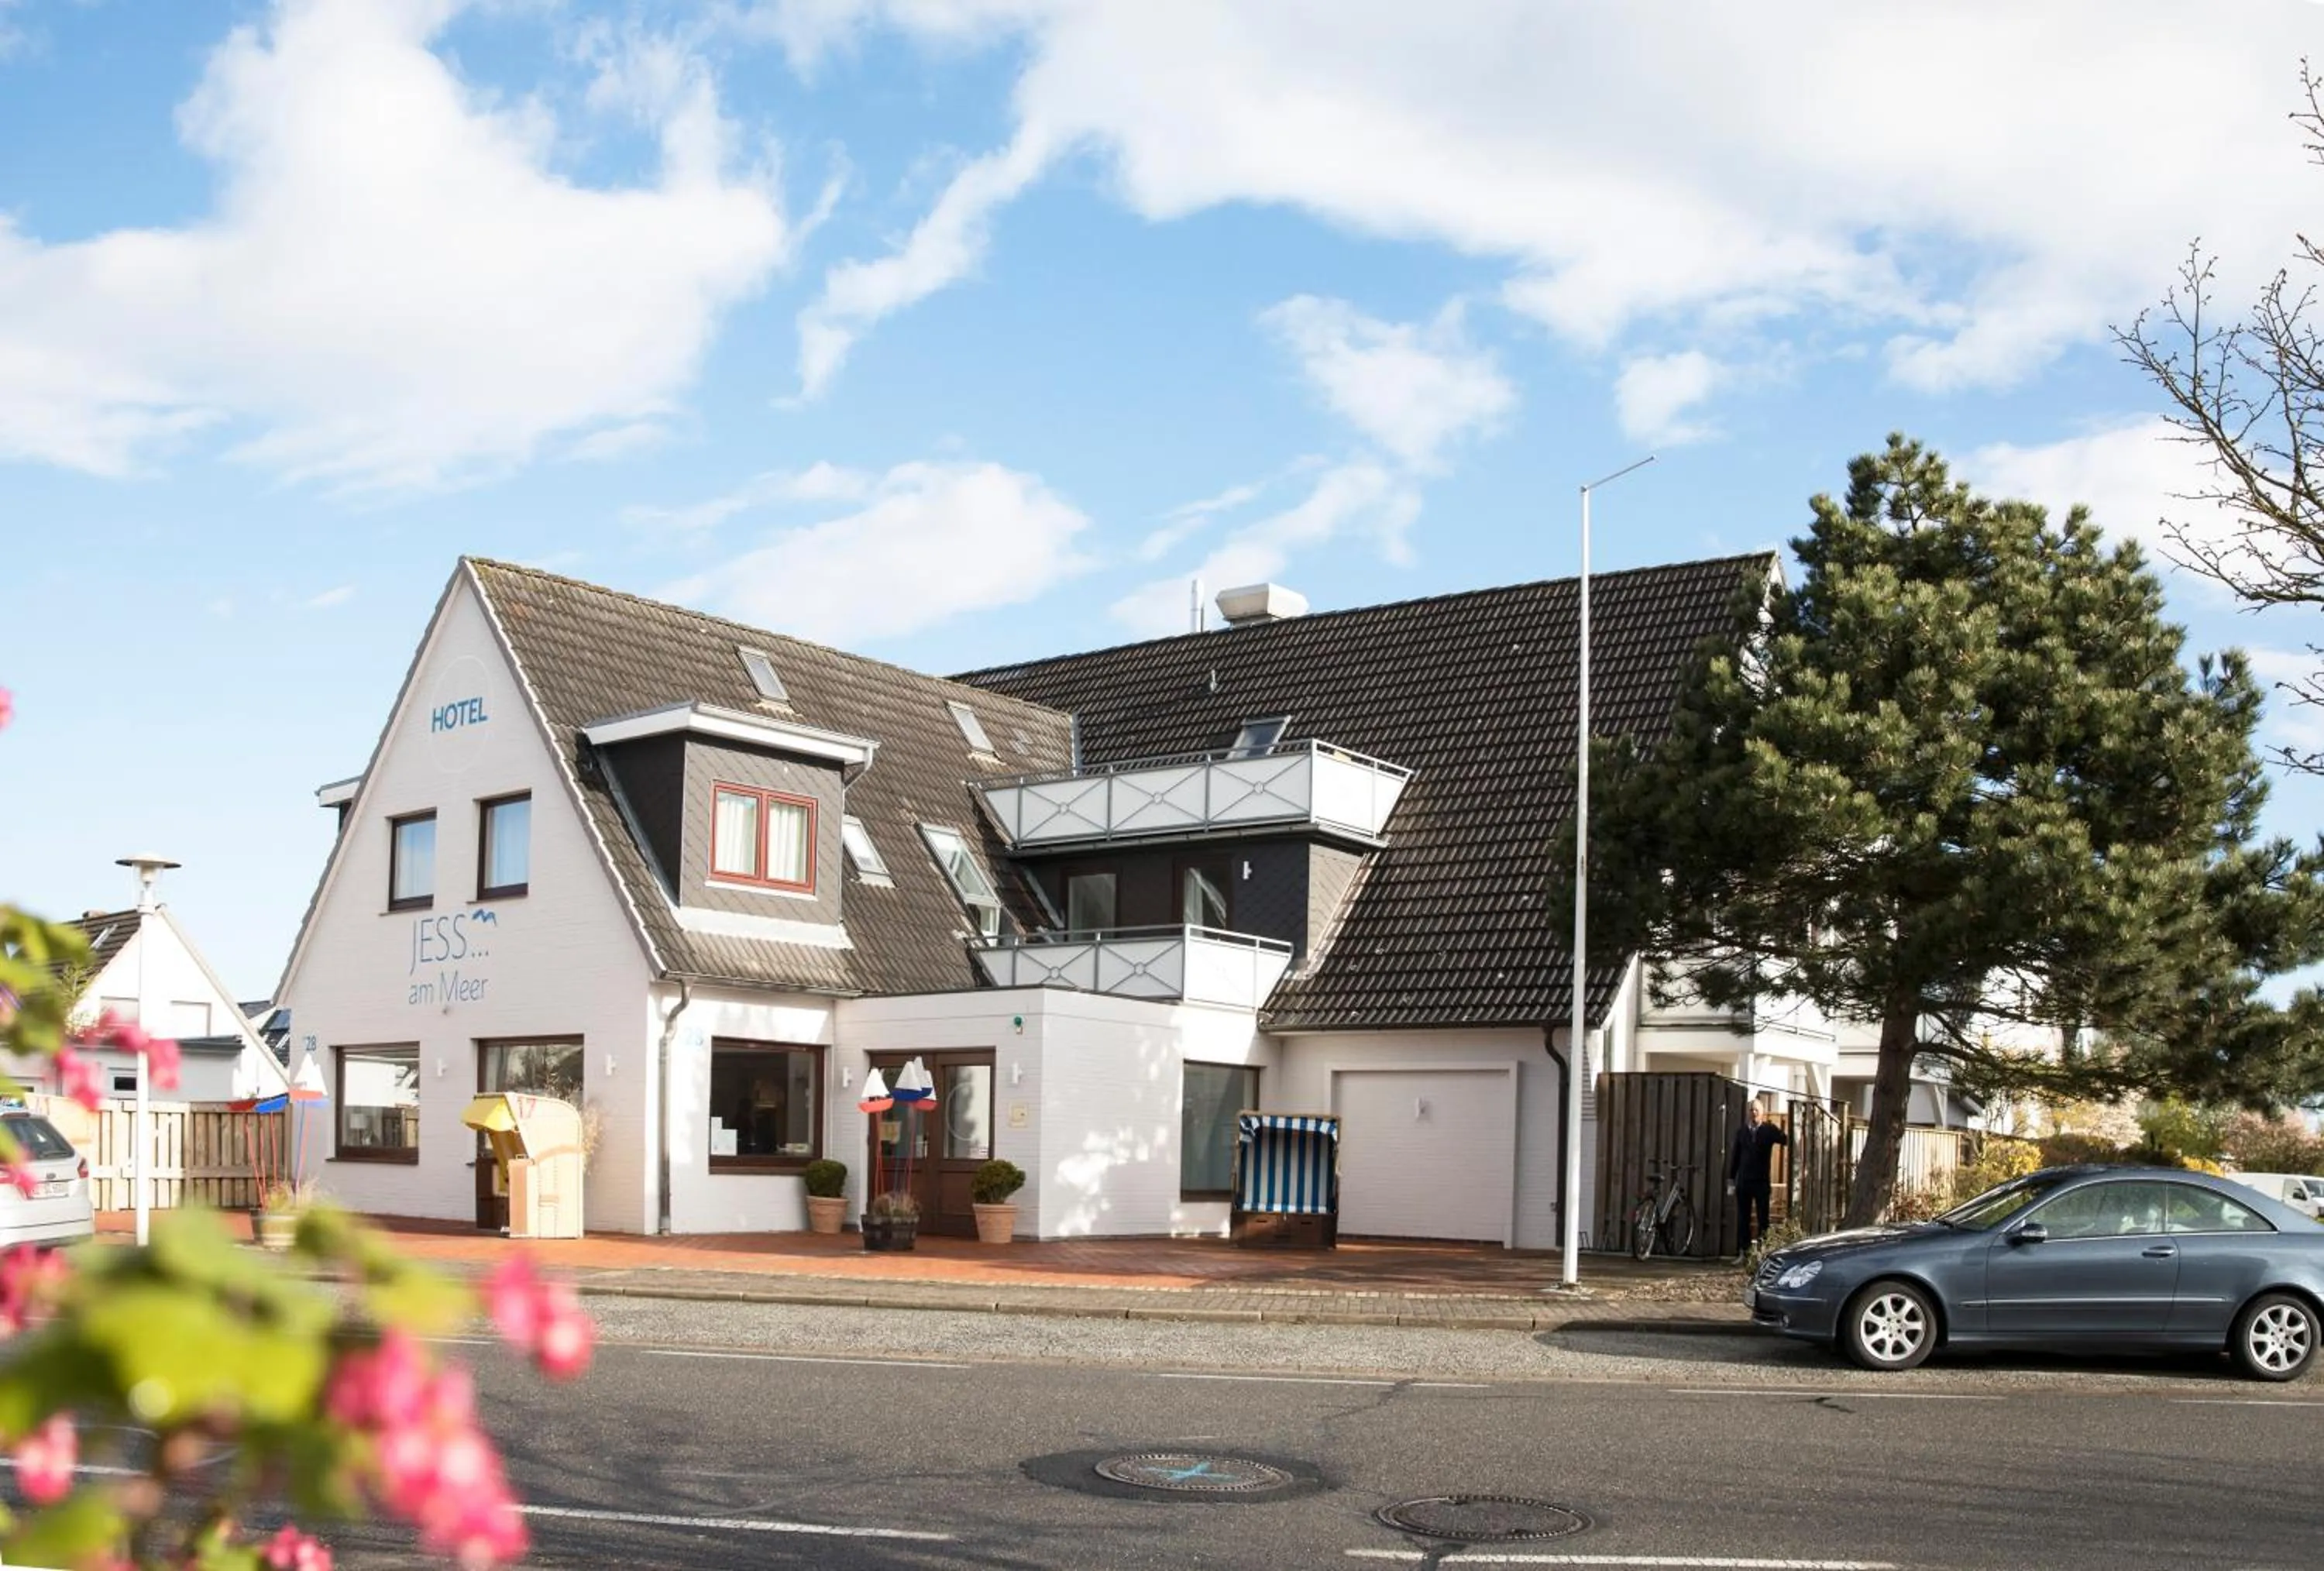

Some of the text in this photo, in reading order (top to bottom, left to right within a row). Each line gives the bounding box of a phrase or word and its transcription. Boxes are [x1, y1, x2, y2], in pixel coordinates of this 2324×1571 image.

[431, 696, 488, 733] HOTEL
[408, 970, 489, 1005] am Meer
[517, 1095, 536, 1119] 17
